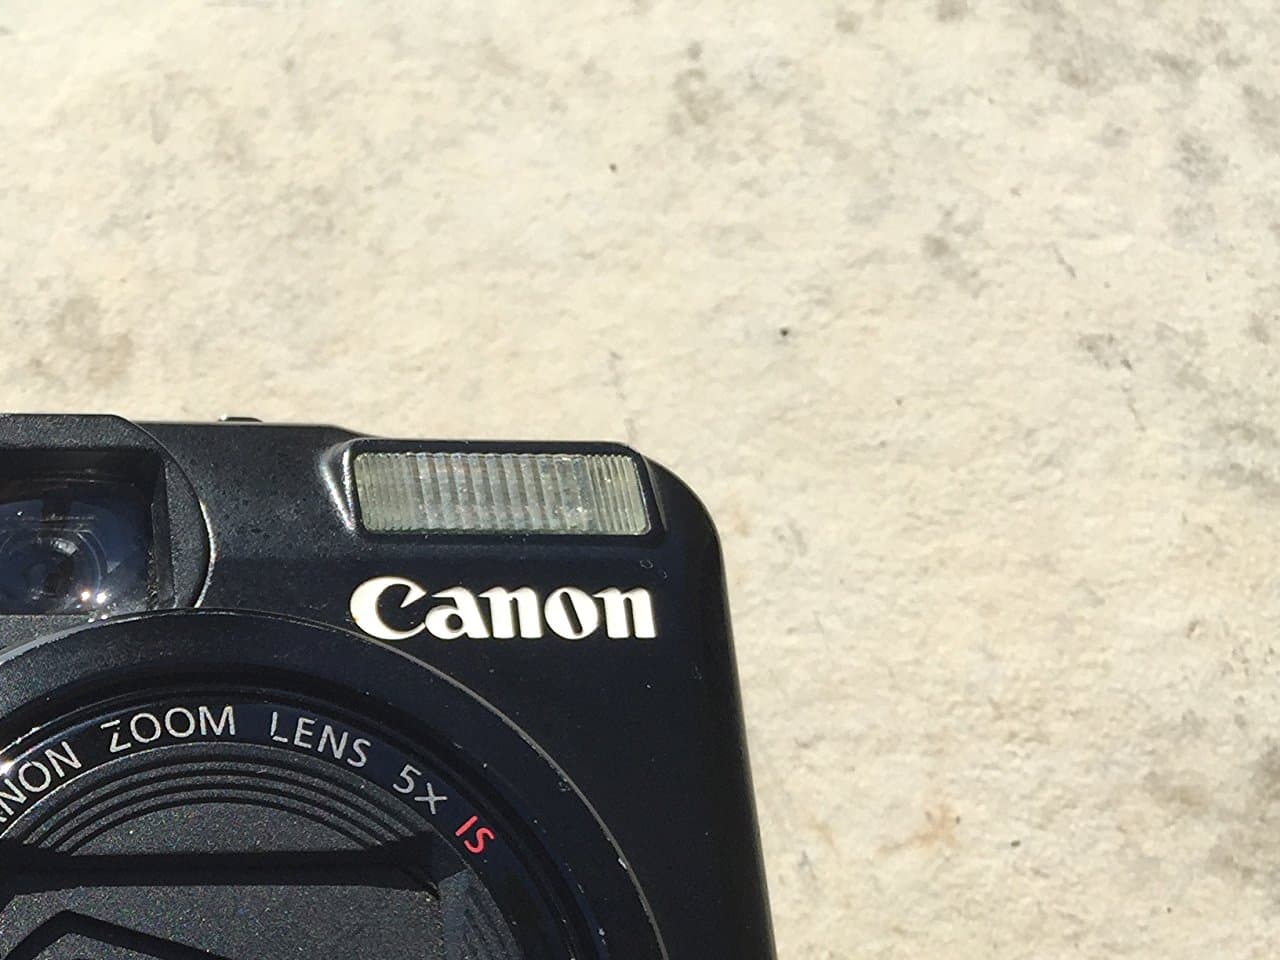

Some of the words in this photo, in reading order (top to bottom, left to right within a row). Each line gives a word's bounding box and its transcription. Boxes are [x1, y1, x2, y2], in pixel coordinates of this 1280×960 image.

[350, 576, 658, 640] Canon
[100, 705, 237, 754] ZOOM
[270, 710, 373, 769] LENS
[455, 815, 496, 854] IS
